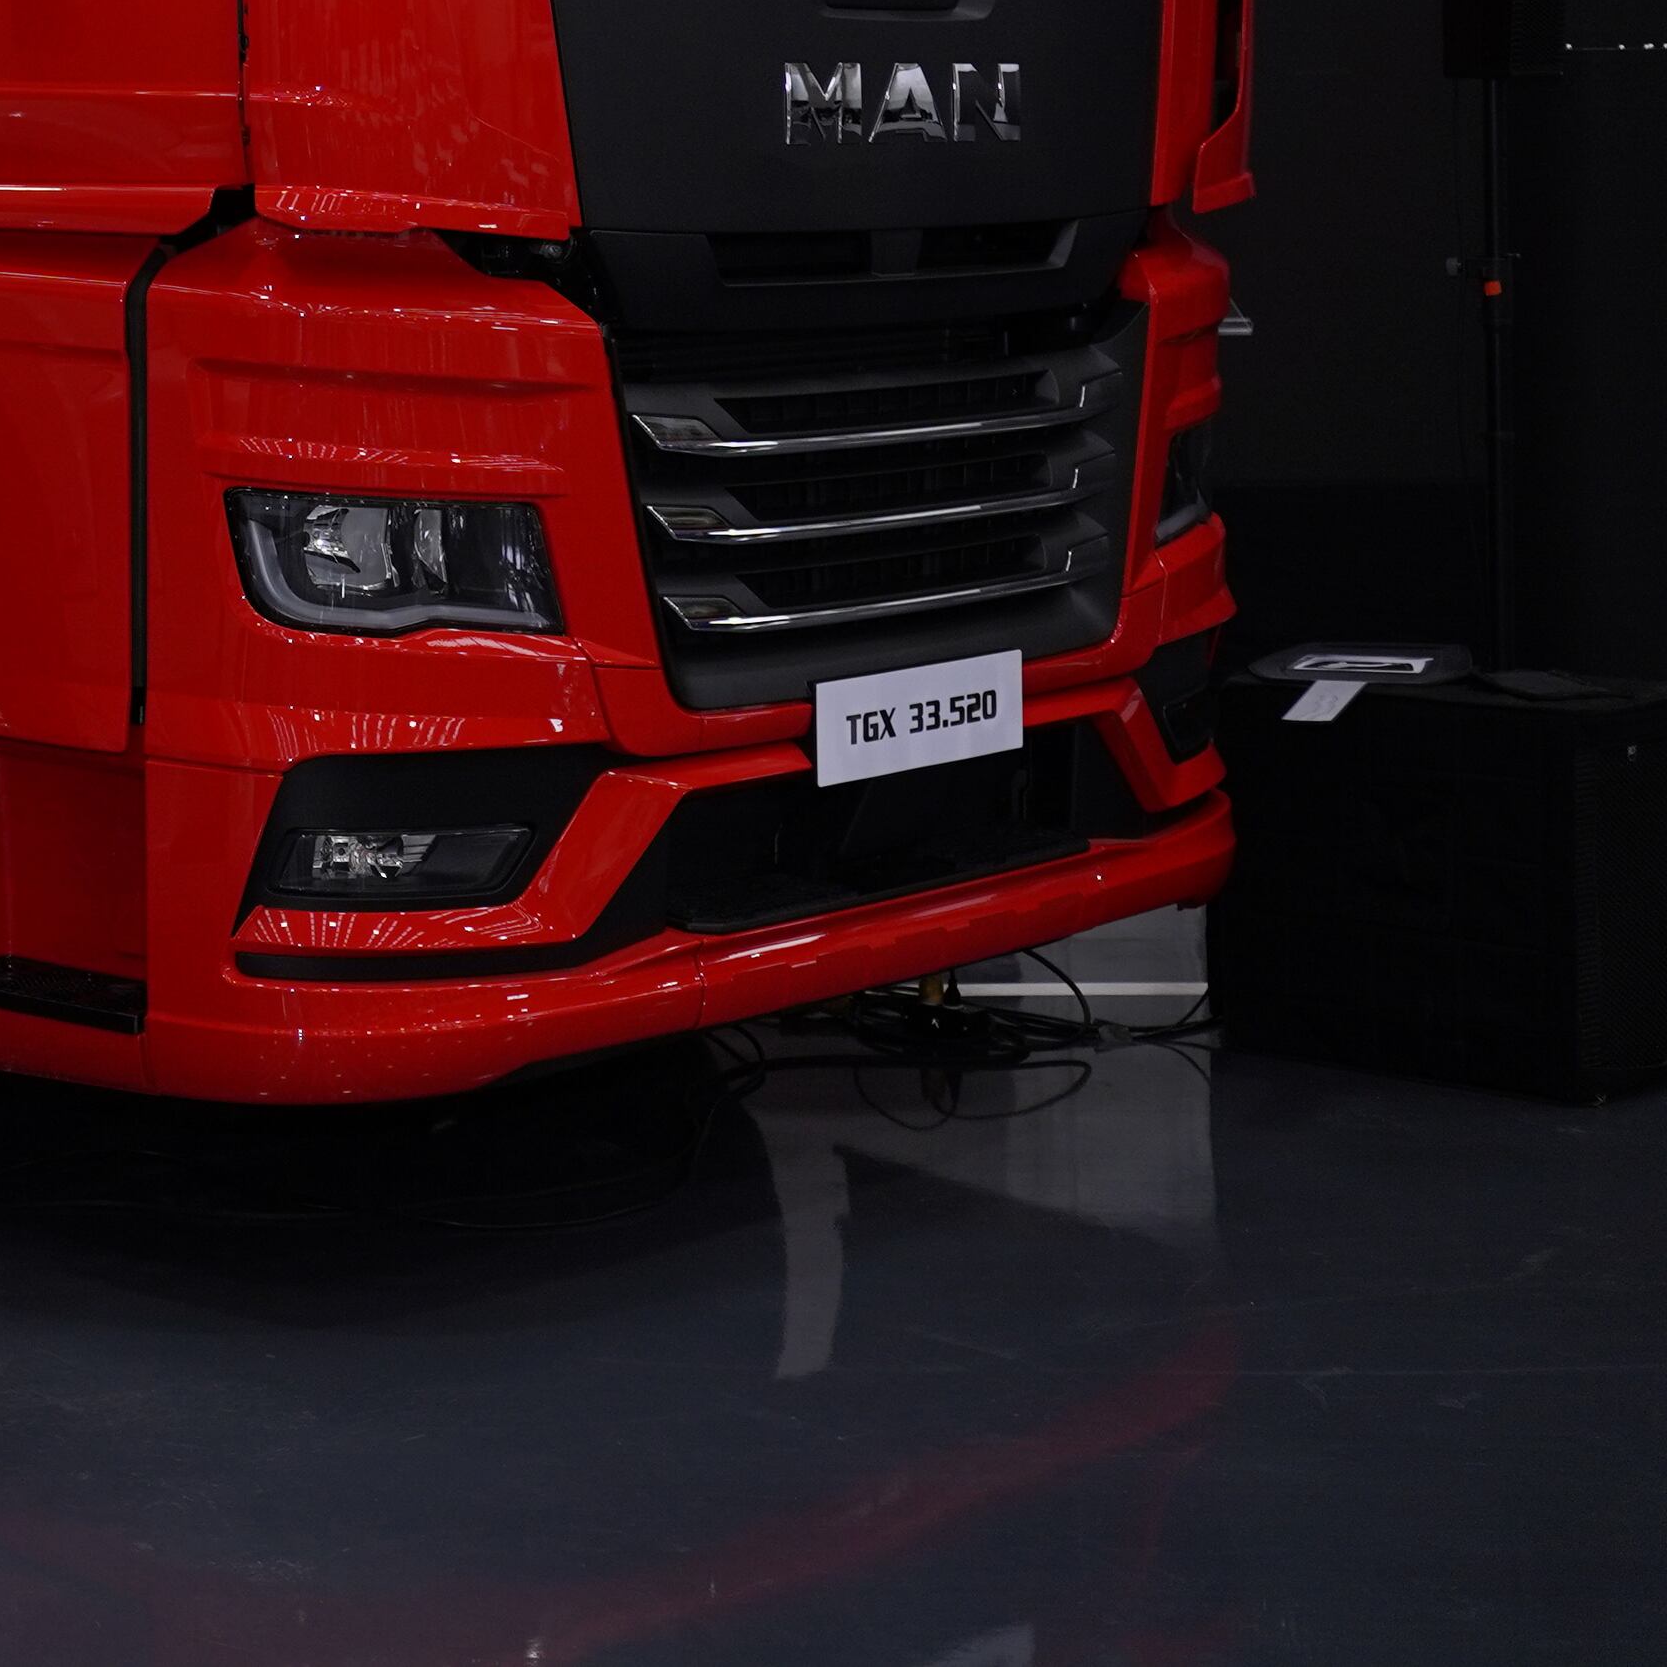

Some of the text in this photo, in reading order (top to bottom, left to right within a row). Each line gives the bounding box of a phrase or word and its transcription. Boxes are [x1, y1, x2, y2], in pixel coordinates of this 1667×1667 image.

[784, 62, 1021, 145] MAN
[846, 689, 997, 745] TGX 33.520
